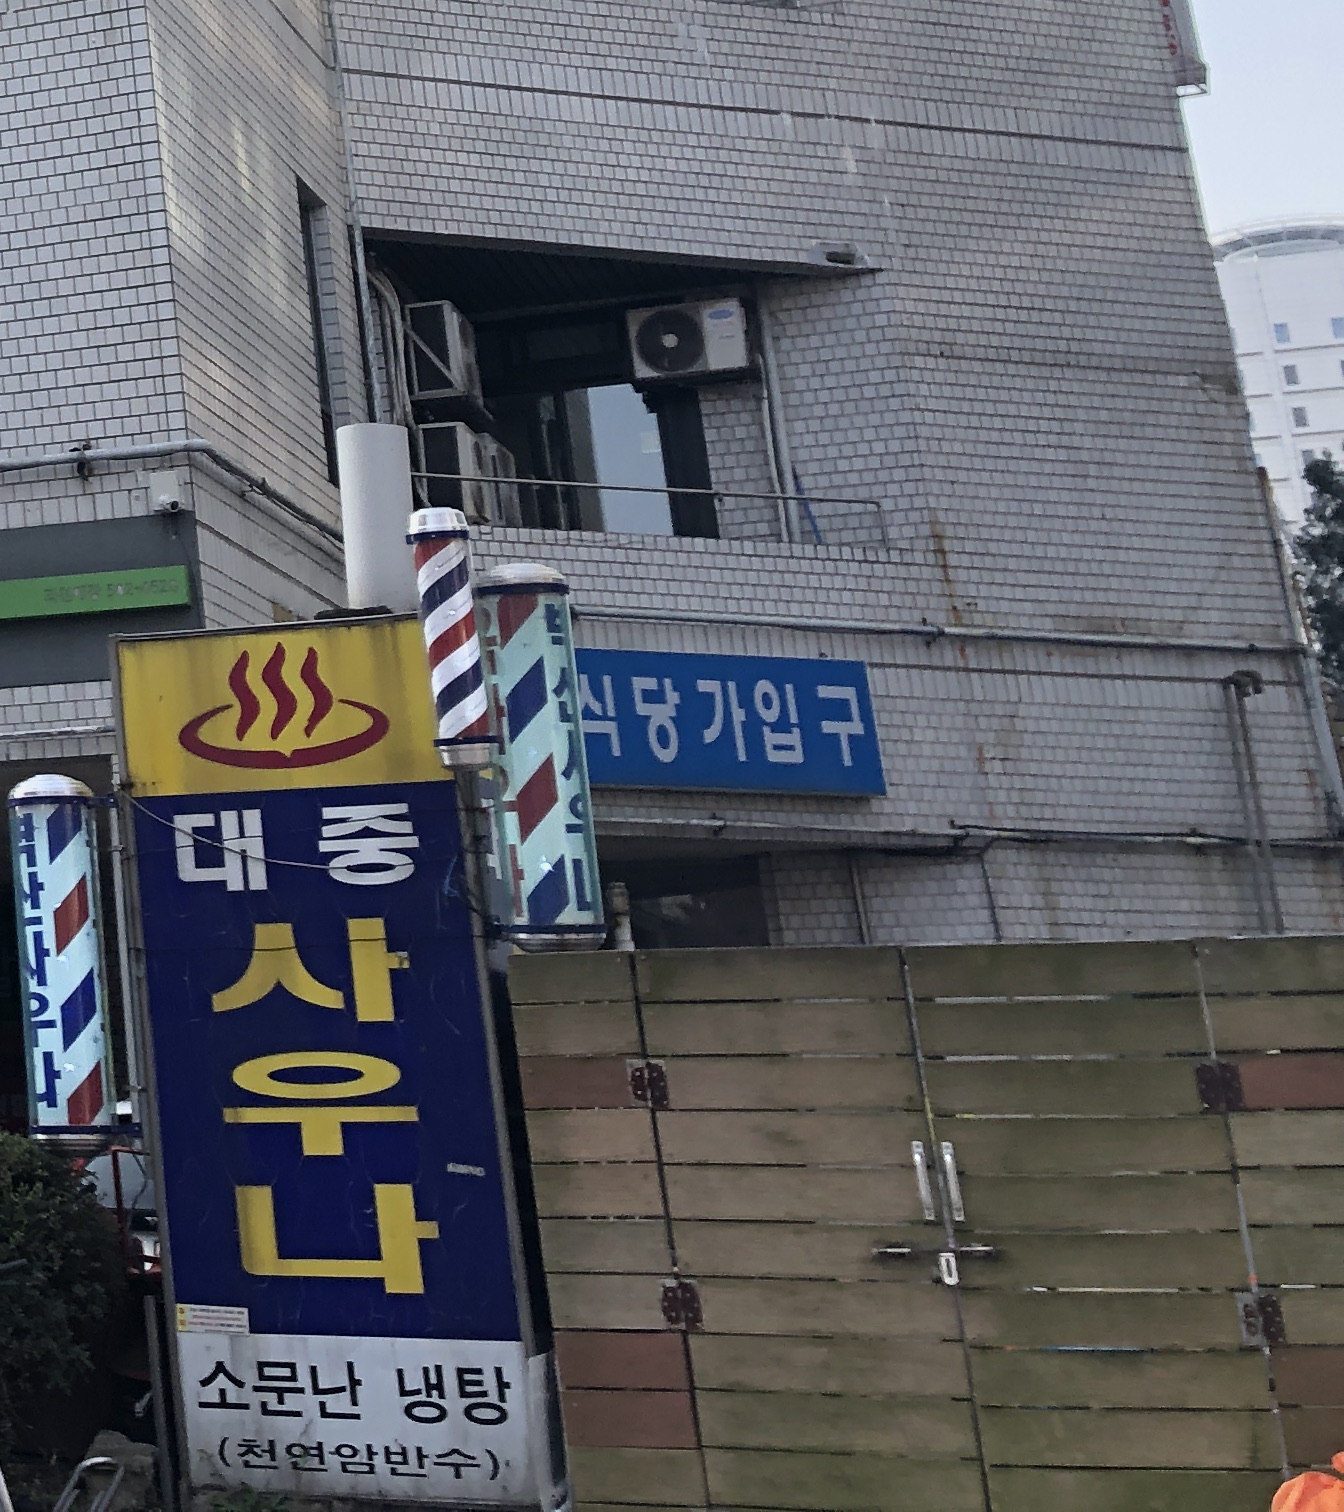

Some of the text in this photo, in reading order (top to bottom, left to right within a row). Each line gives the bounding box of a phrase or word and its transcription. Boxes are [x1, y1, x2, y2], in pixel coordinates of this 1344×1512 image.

[197, 1359, 513, 1427] 소문난 냉탕
[216, 1435, 503, 1483] (천연암반수)
